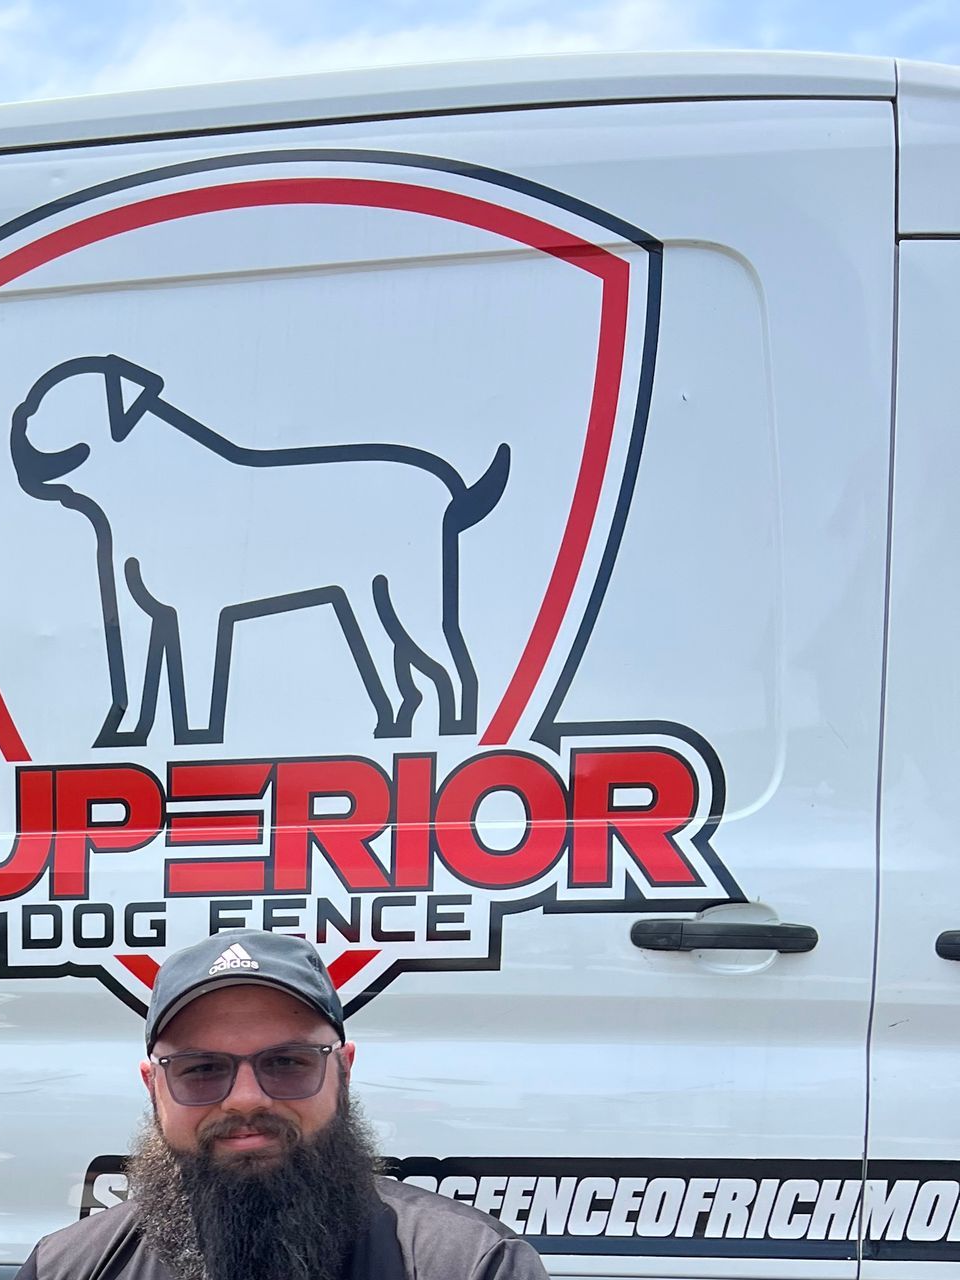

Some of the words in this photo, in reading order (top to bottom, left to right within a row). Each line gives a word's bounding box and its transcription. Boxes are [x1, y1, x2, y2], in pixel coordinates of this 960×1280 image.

[21, 902, 167, 949] DOG
[209, 895, 472, 944] FENCE
[208, 959, 260, 976] adidas
